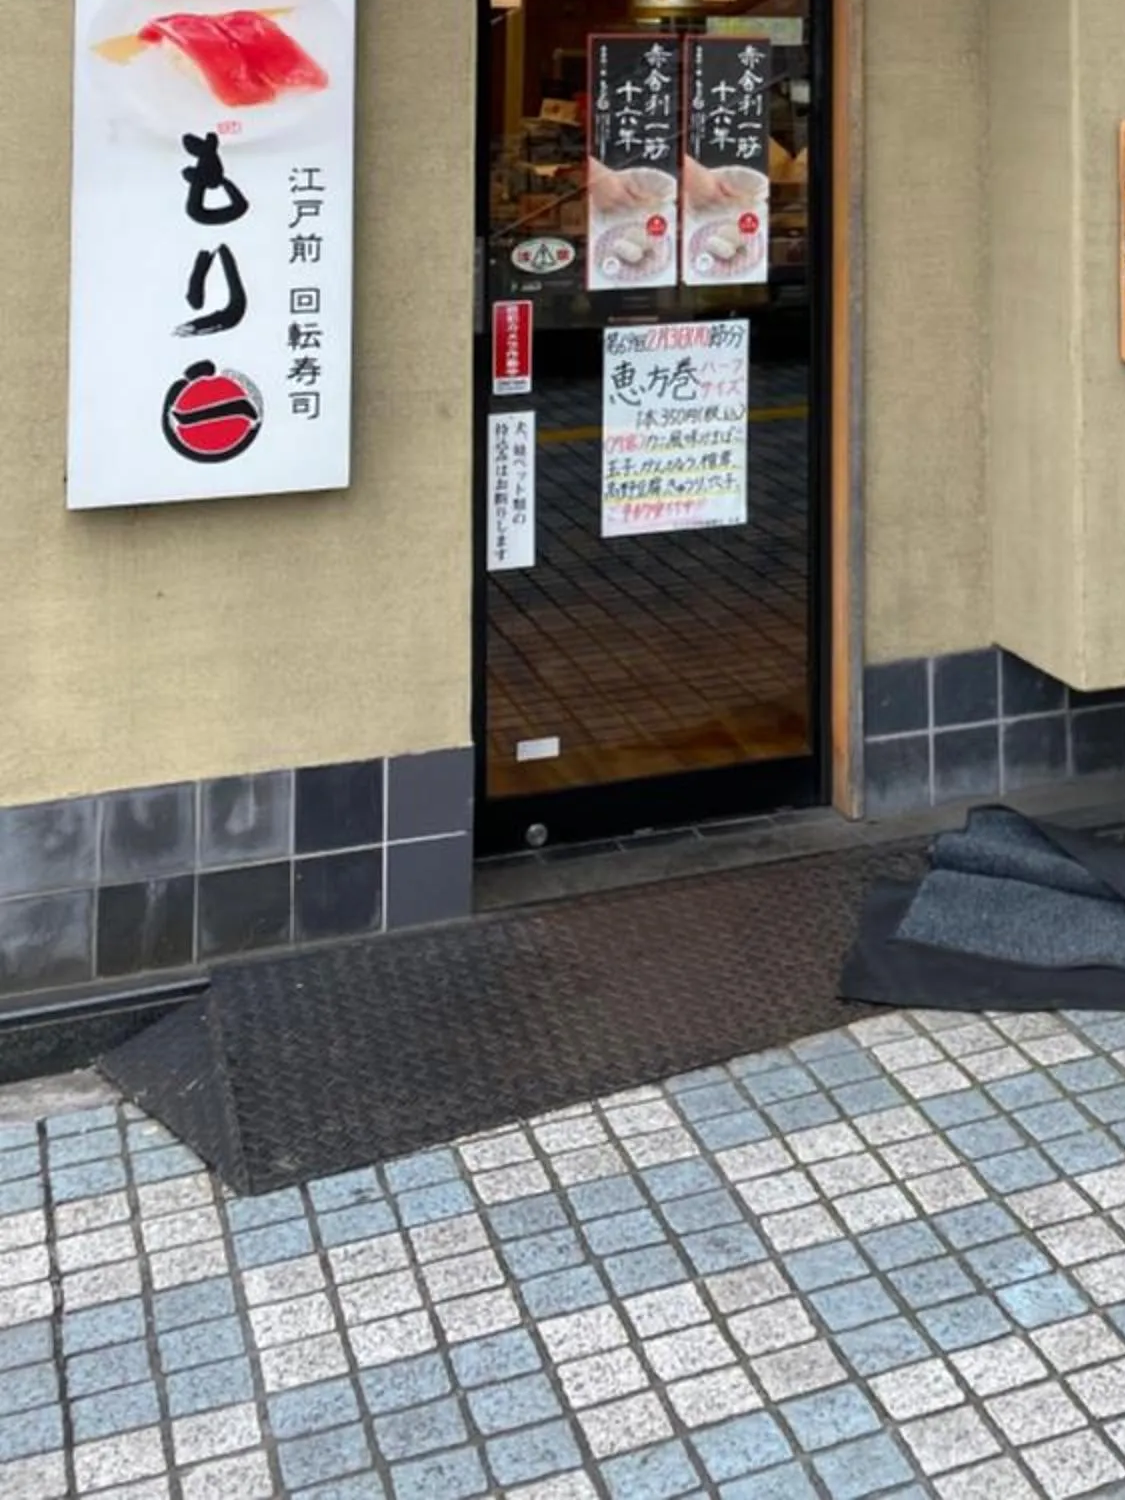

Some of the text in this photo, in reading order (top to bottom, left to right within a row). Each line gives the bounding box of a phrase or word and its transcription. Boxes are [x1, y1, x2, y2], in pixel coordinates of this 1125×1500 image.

[614, 80, 643, 153] 十六年
[709, 80, 737, 151] 十六年
[286, 167, 326, 420] 江戸前 回転寿司
[609, 356, 700, 406] 恵方巻
